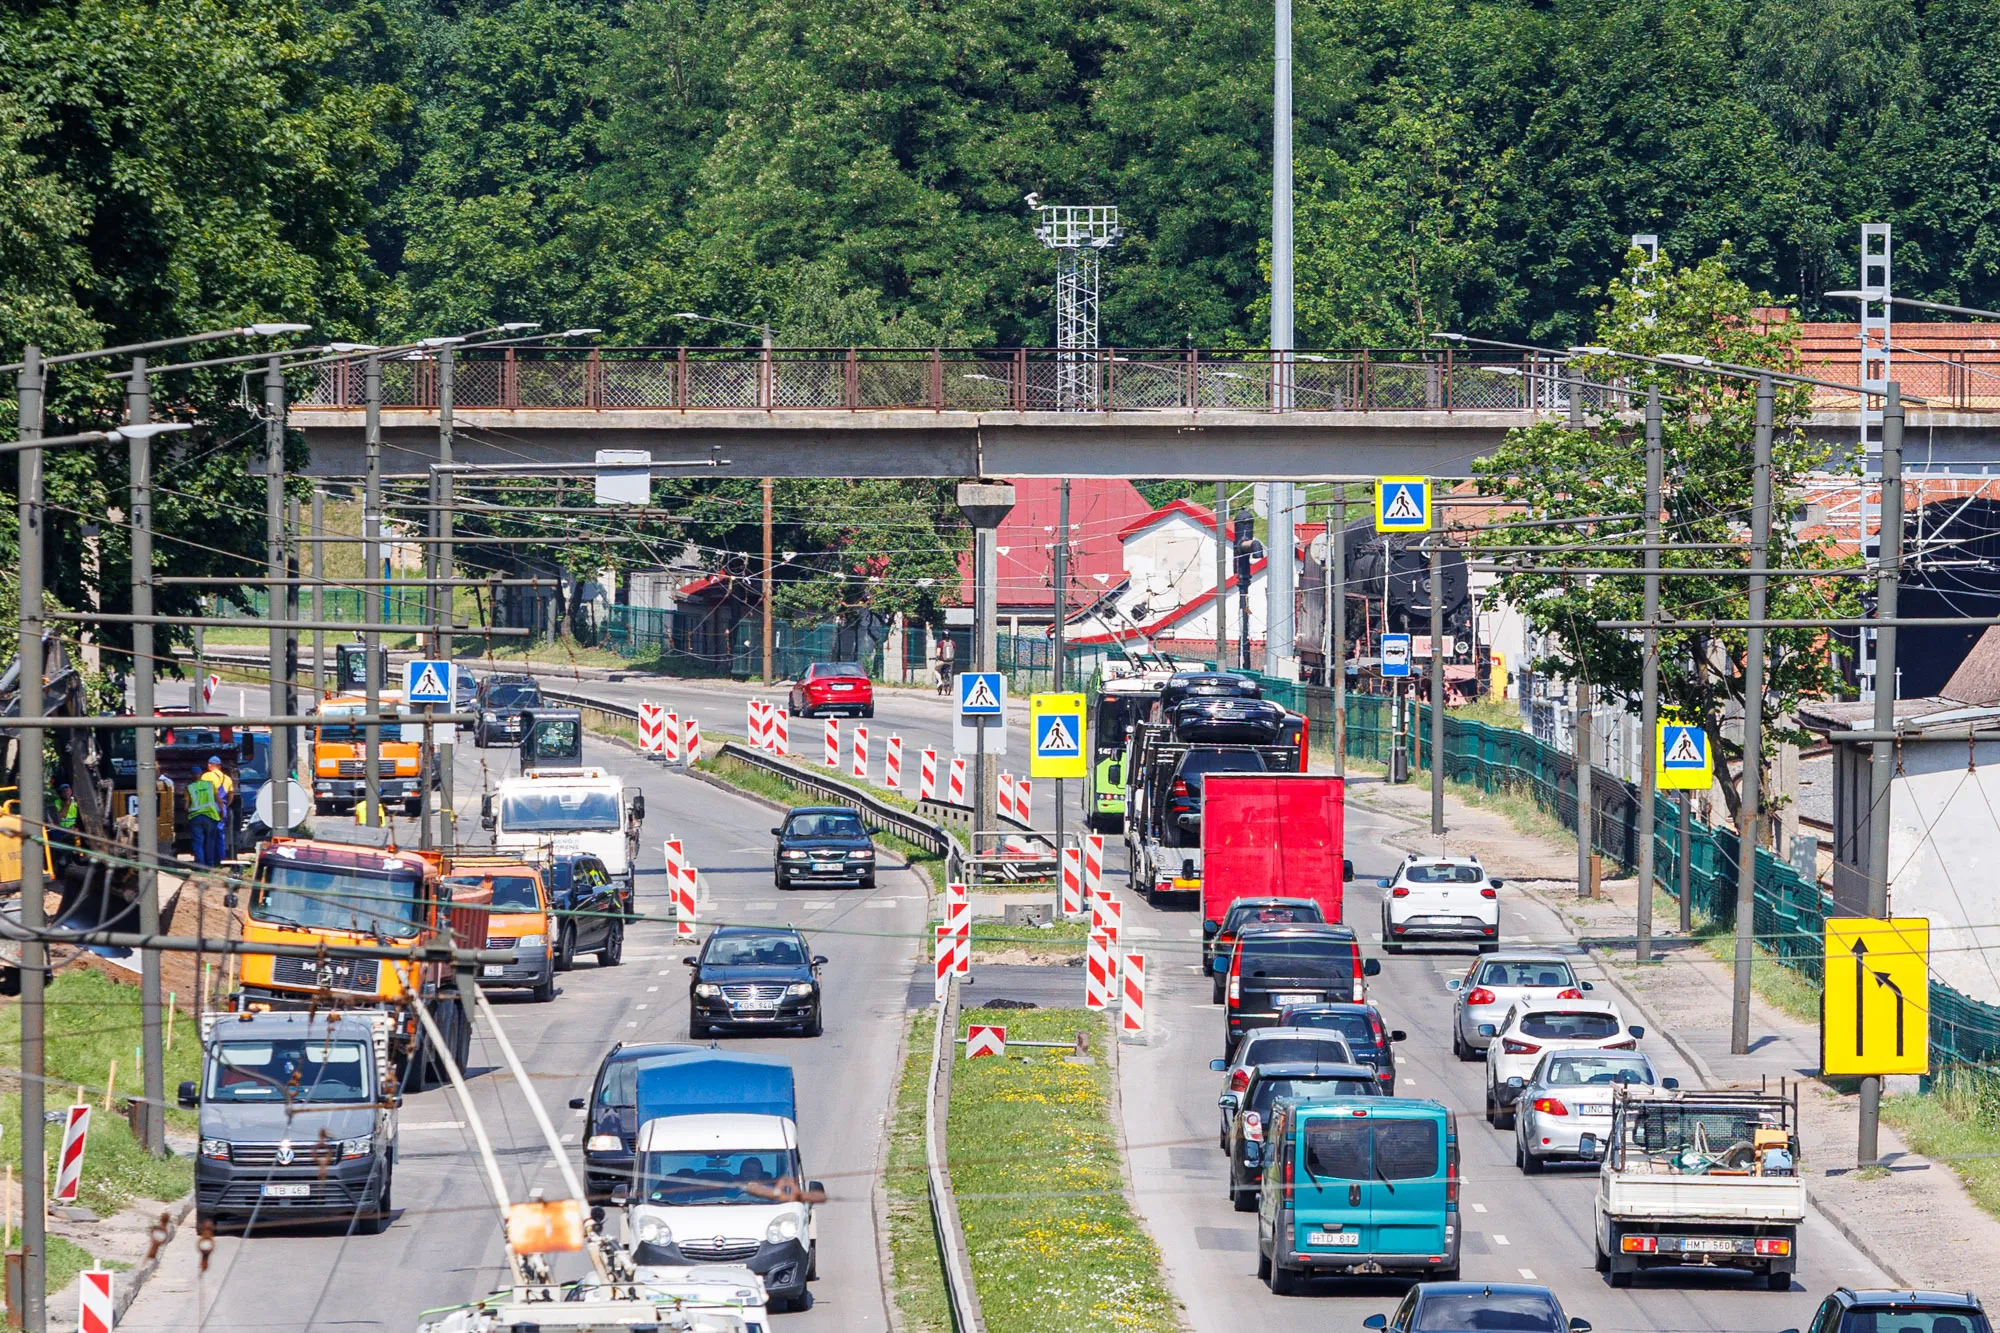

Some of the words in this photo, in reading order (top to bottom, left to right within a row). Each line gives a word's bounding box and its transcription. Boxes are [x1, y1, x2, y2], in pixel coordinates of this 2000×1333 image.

[302, 961, 349, 976] MAN
[1585, 1105, 1603, 1113] JNO
[292, 1186, 308, 1195] 463
[1312, 1234, 1334, 1243] HTD
[1339, 1235, 1357, 1244] 612
[1686, 1241, 1706, 1249] HMT
[1713, 1241, 1730, 1250] 560
